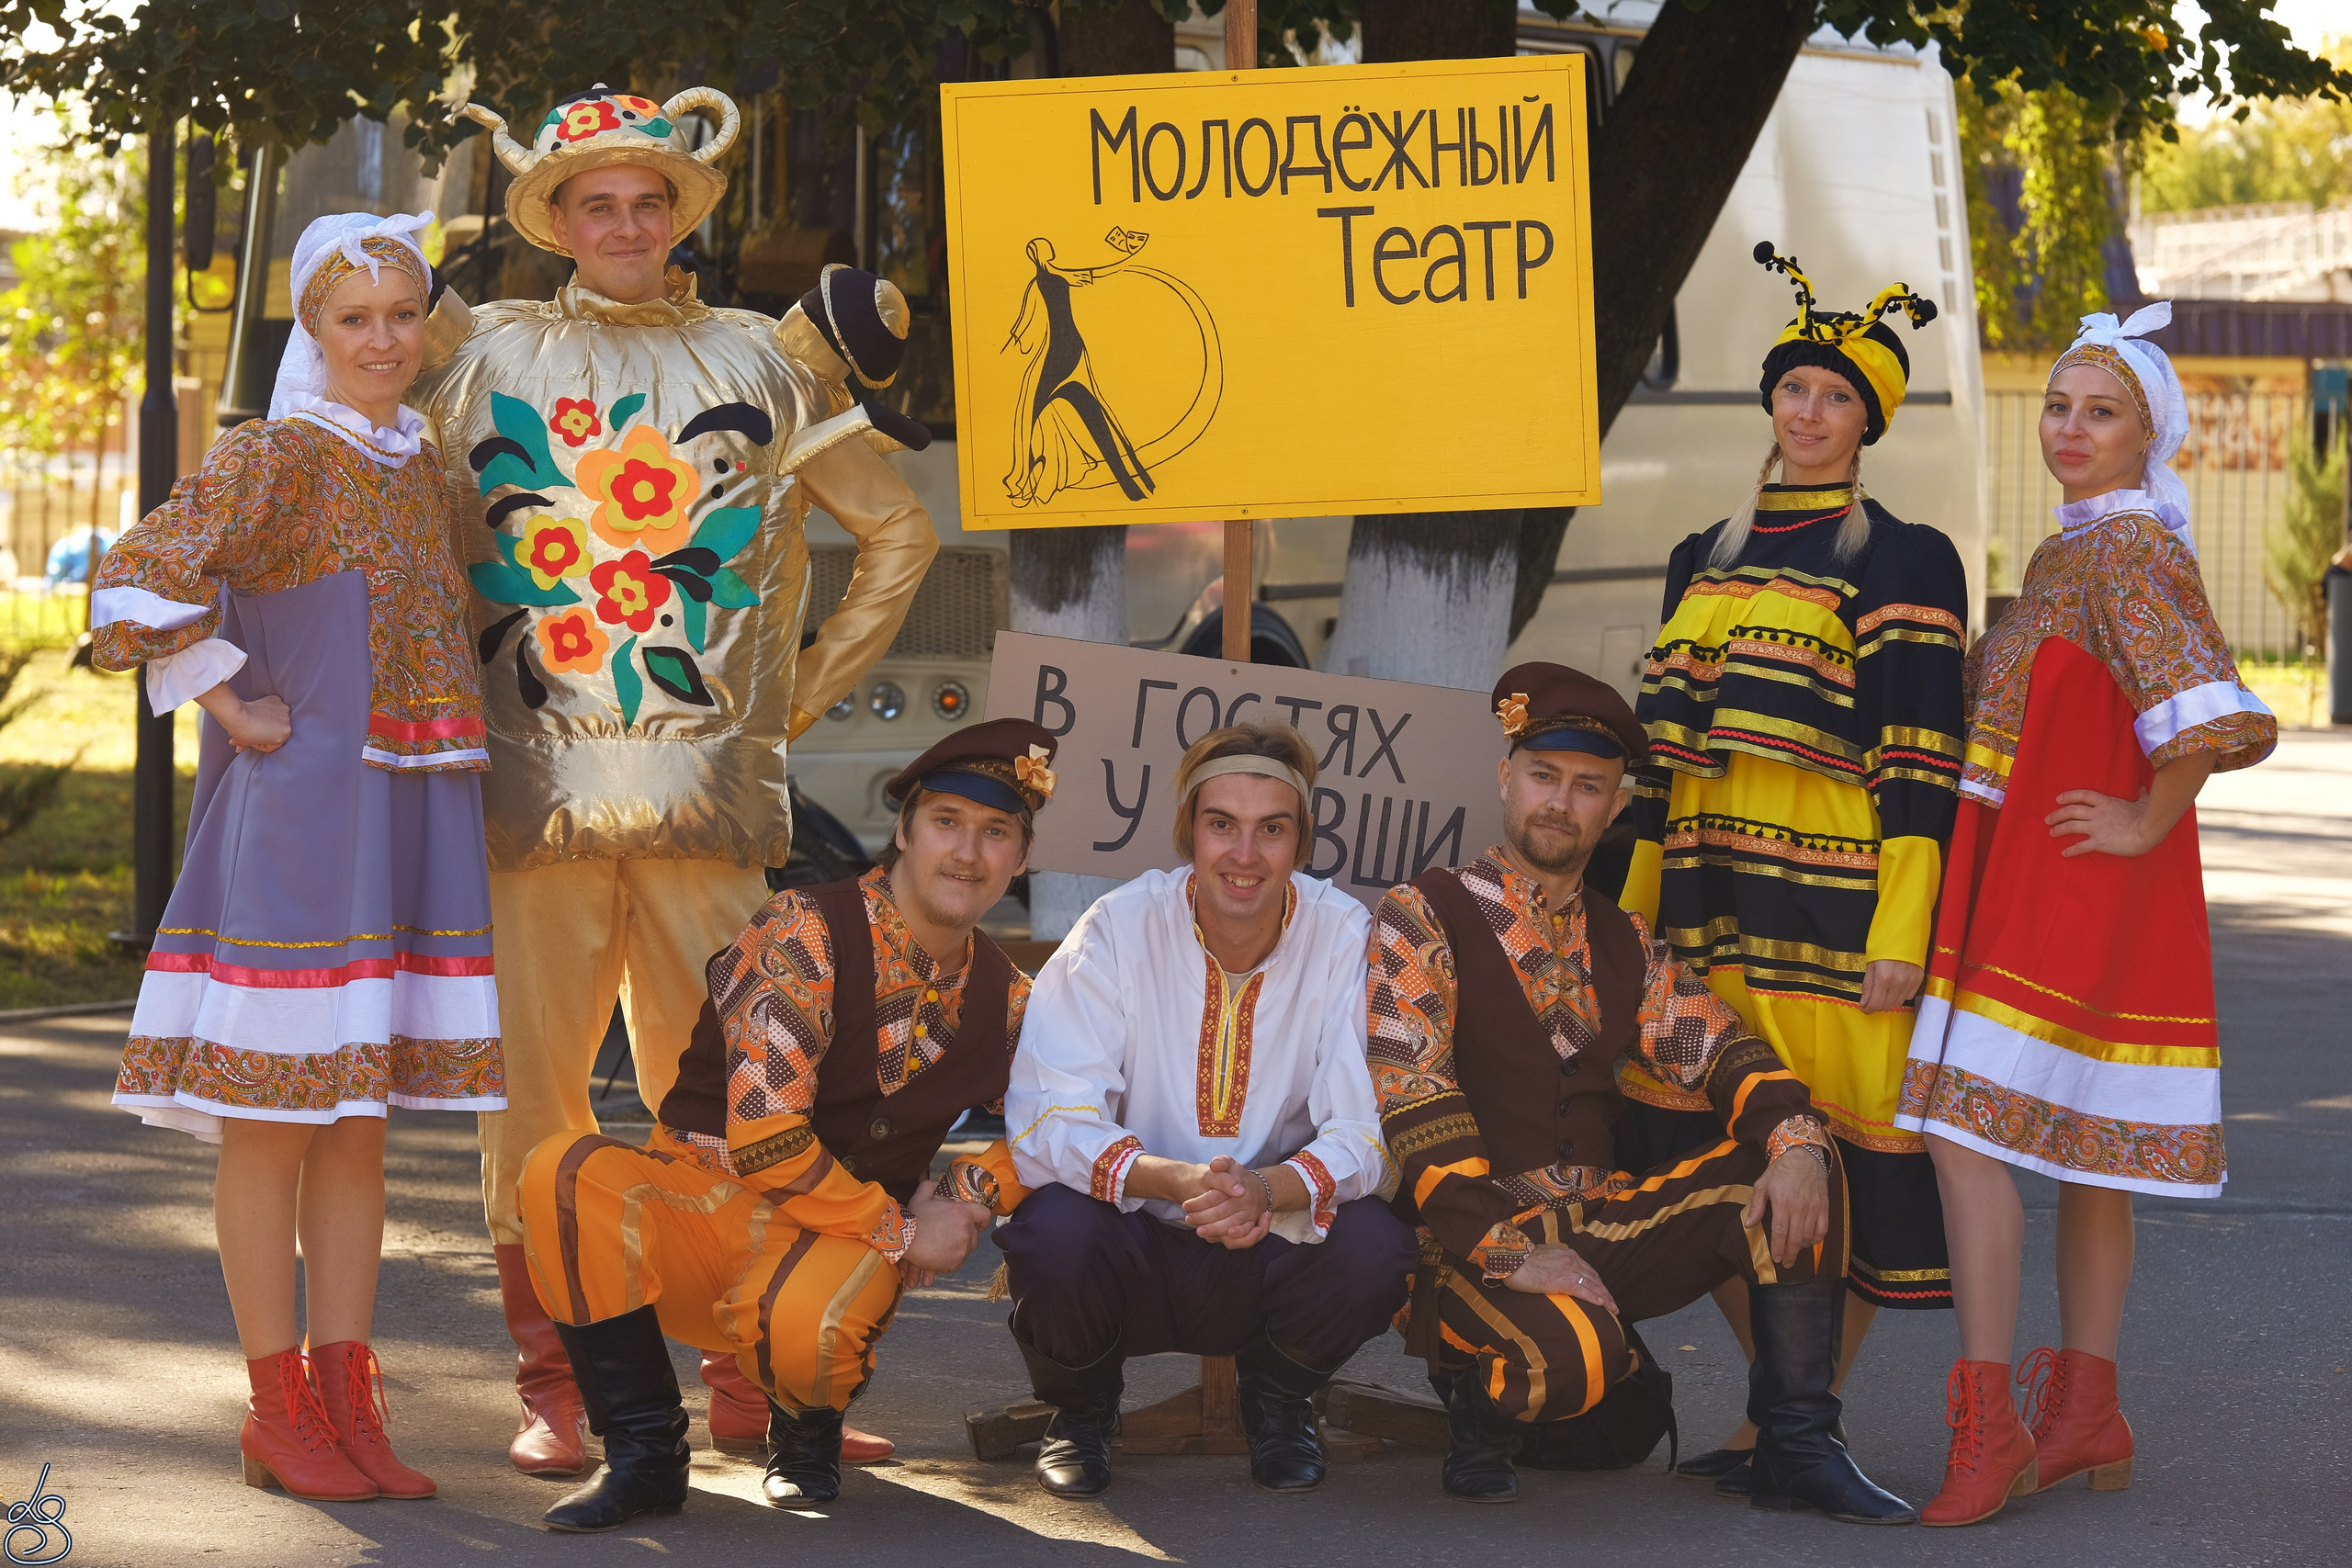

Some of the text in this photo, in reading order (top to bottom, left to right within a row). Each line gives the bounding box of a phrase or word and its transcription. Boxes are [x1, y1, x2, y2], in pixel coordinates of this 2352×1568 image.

[1090, 94, 1555, 205] Молодёжный
[1317, 205, 1555, 308] Театр
[1034, 664, 1076, 738] В
[1092, 758, 1466, 889] У ВШИ
